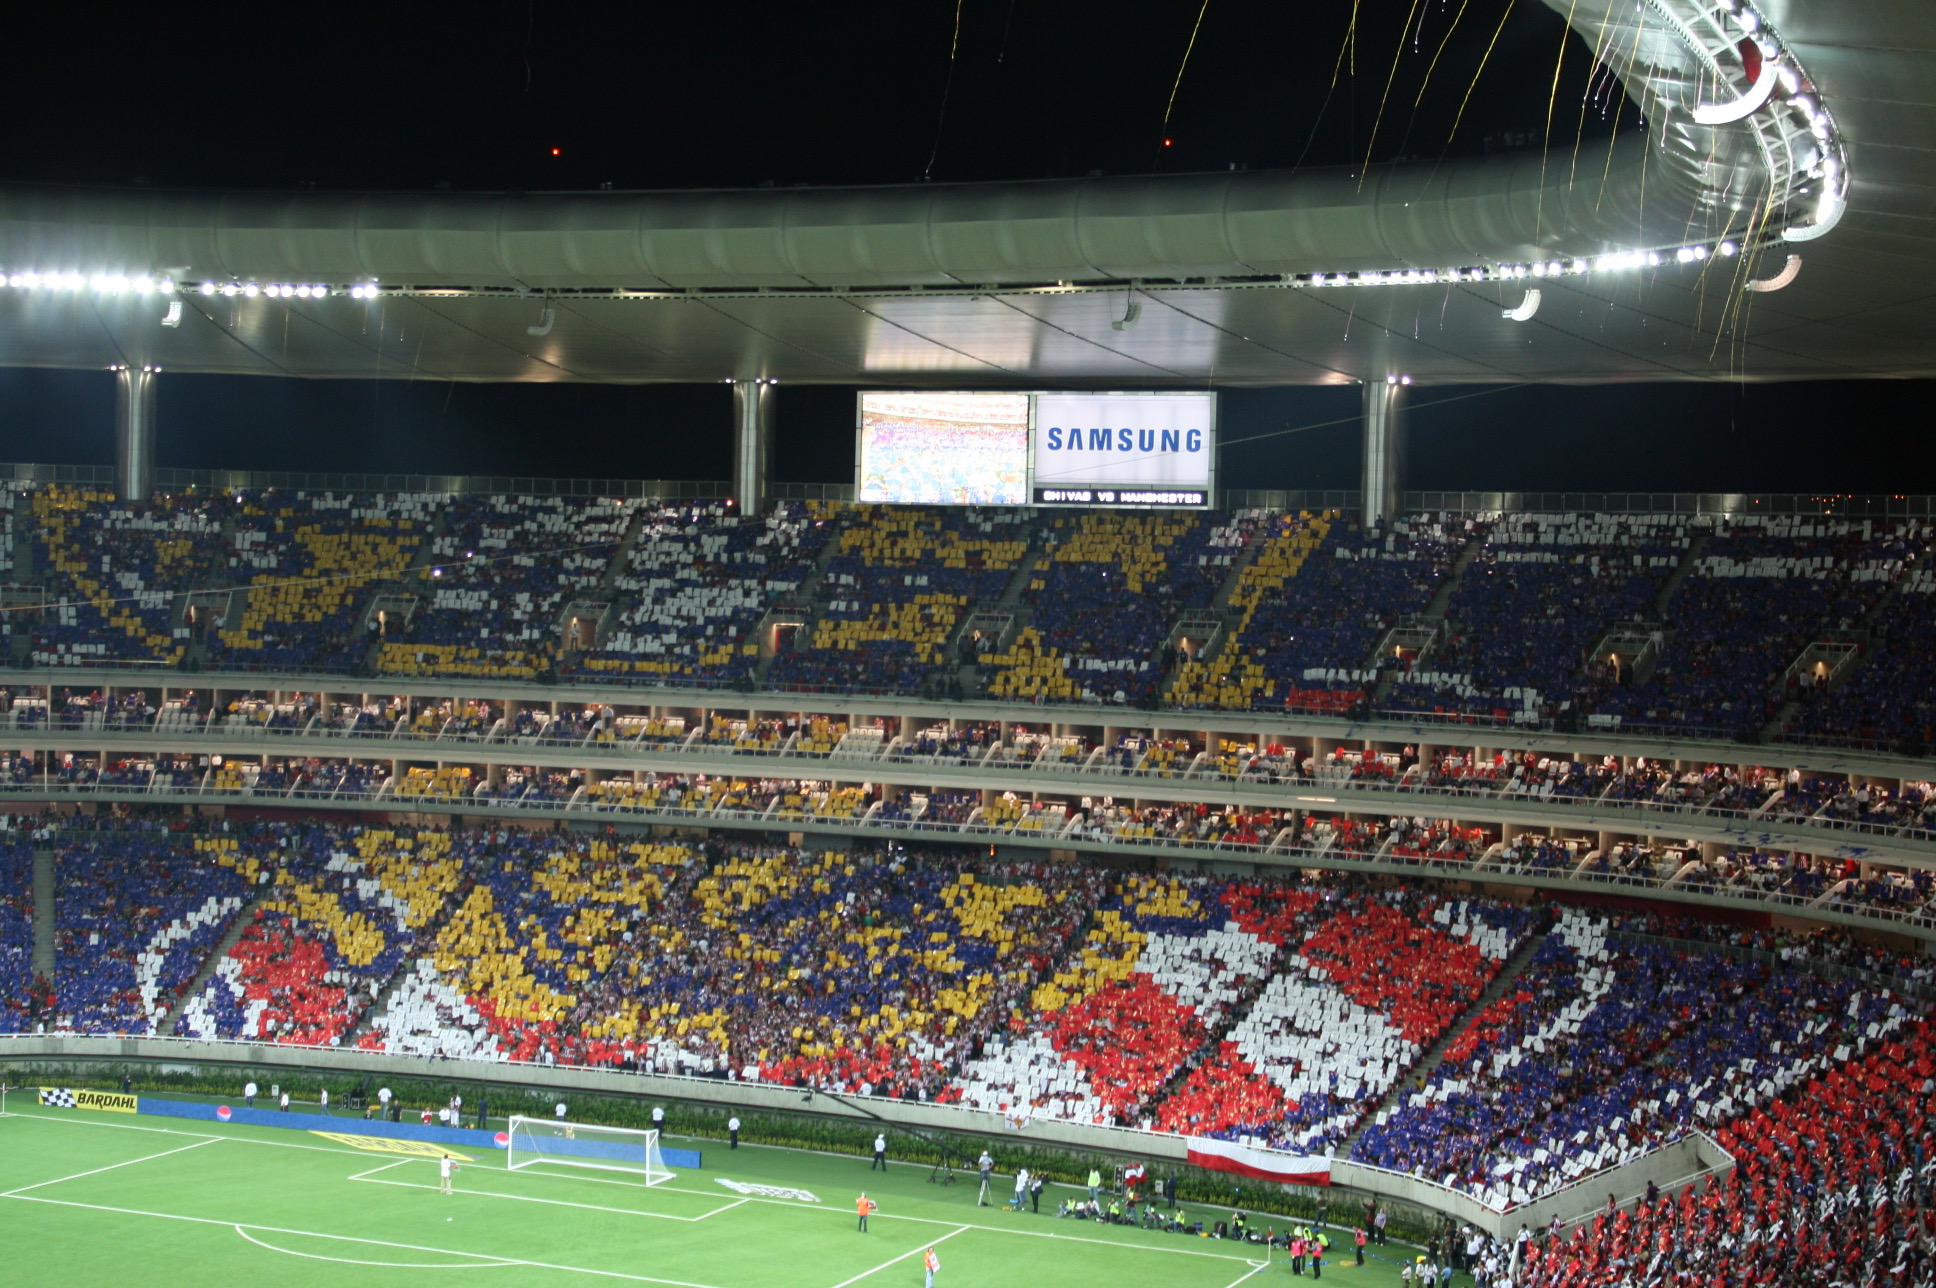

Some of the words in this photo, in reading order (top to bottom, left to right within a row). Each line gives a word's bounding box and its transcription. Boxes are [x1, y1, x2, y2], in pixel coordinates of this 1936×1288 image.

[1048, 427, 1202, 452] SAMSUNG
[1097, 491, 1115, 502] VS
[1120, 492, 1202, 504] MANCHESTER
[77, 1092, 136, 1109] BARDAHL
